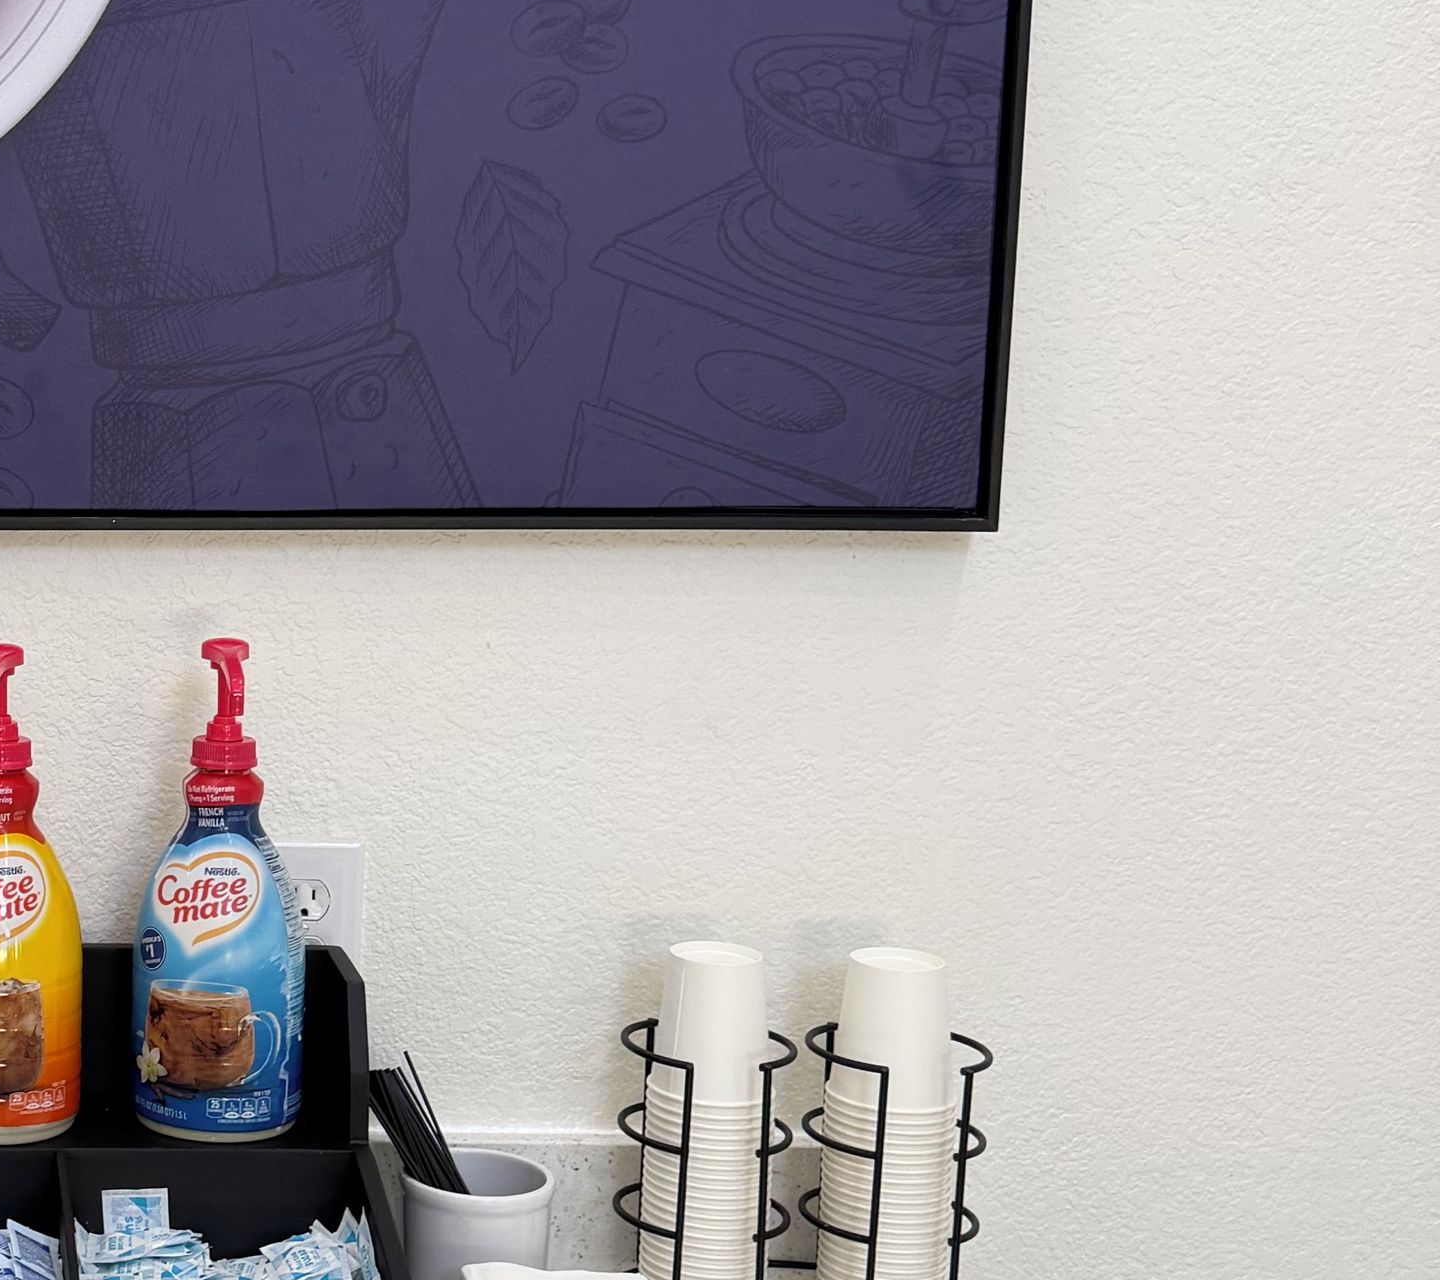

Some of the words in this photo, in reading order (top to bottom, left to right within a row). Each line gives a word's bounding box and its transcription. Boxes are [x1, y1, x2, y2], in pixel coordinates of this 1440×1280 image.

[201, 785, 235, 795] Refrigerate
[210, 794, 235, 803] Serving
[198, 807, 224, 817] FRENCH
[197, 818, 225, 828] VANILLA
[157, 874, 248, 906] Coffee
[172, 894, 249, 925] mate
[210, 1100, 220, 1109] 25
